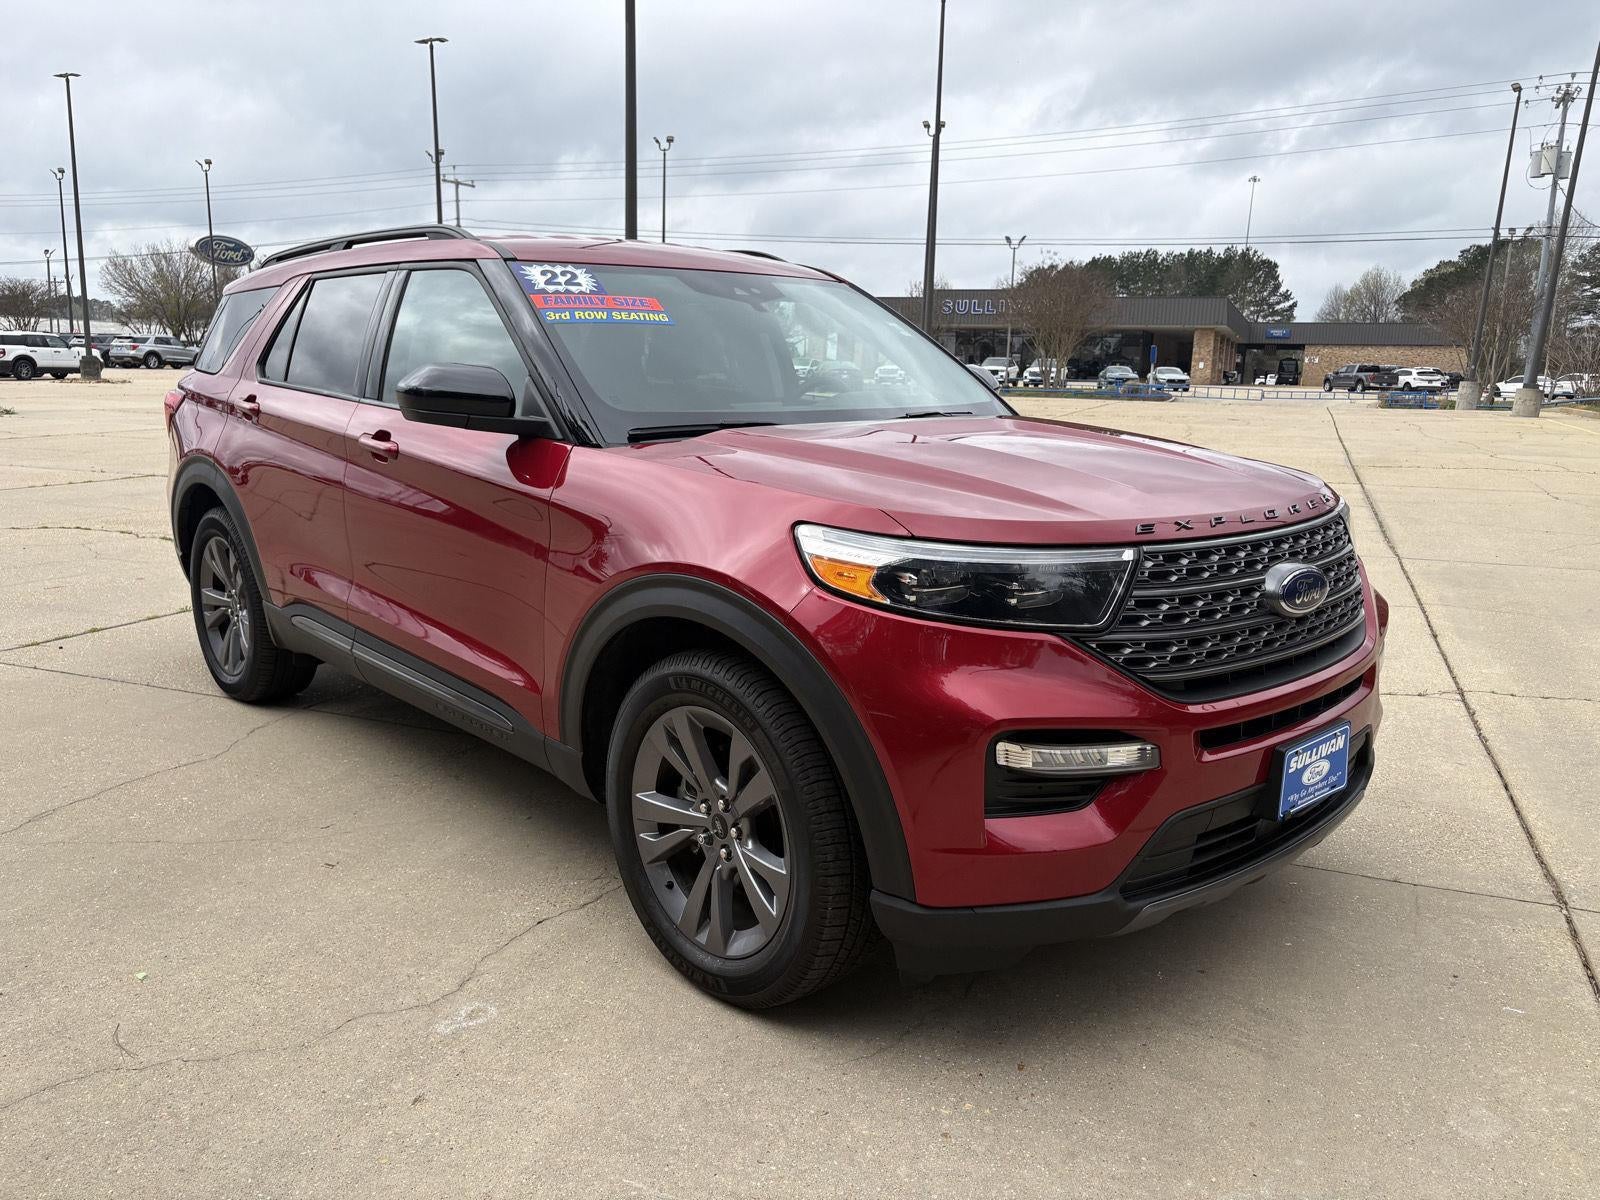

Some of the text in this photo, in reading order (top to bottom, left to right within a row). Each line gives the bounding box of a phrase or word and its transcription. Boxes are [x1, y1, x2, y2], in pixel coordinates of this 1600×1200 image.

[209, 240, 244, 262] Ford
[540, 269, 583, 287] 22
[542, 295, 654, 308] FAMILY SIZE
[546, 311, 669, 322] 3rd ROW SEATING
[1135, 493, 1335, 535] EXPLORER
[1295, 577, 1321, 605] Ford
[1288, 734, 1346, 774] SULLIVAN
